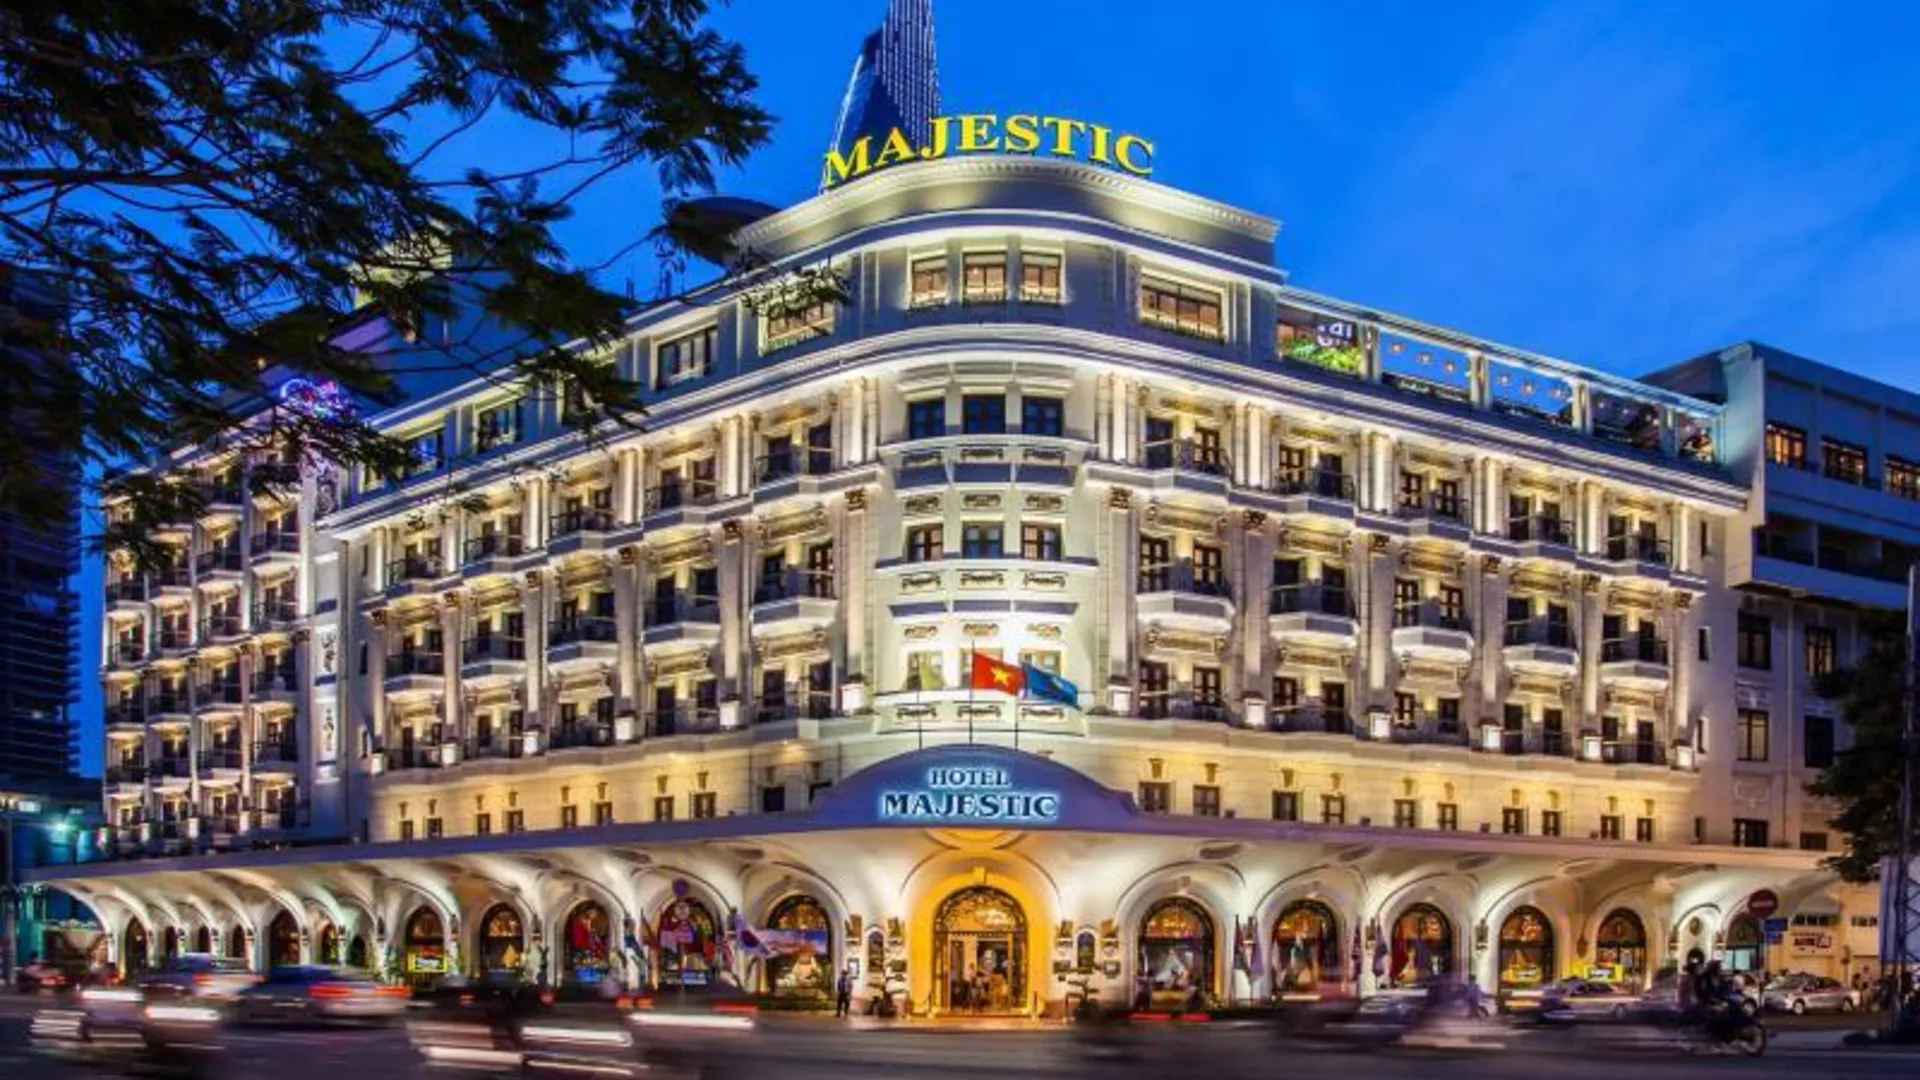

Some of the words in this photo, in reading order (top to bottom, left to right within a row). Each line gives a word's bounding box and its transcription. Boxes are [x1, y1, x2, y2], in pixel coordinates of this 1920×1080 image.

[824, 114, 1156, 186] MAJESTIC
[929, 767, 1011, 788] HOTEL
[880, 791, 1059, 819] MAJESTIC
